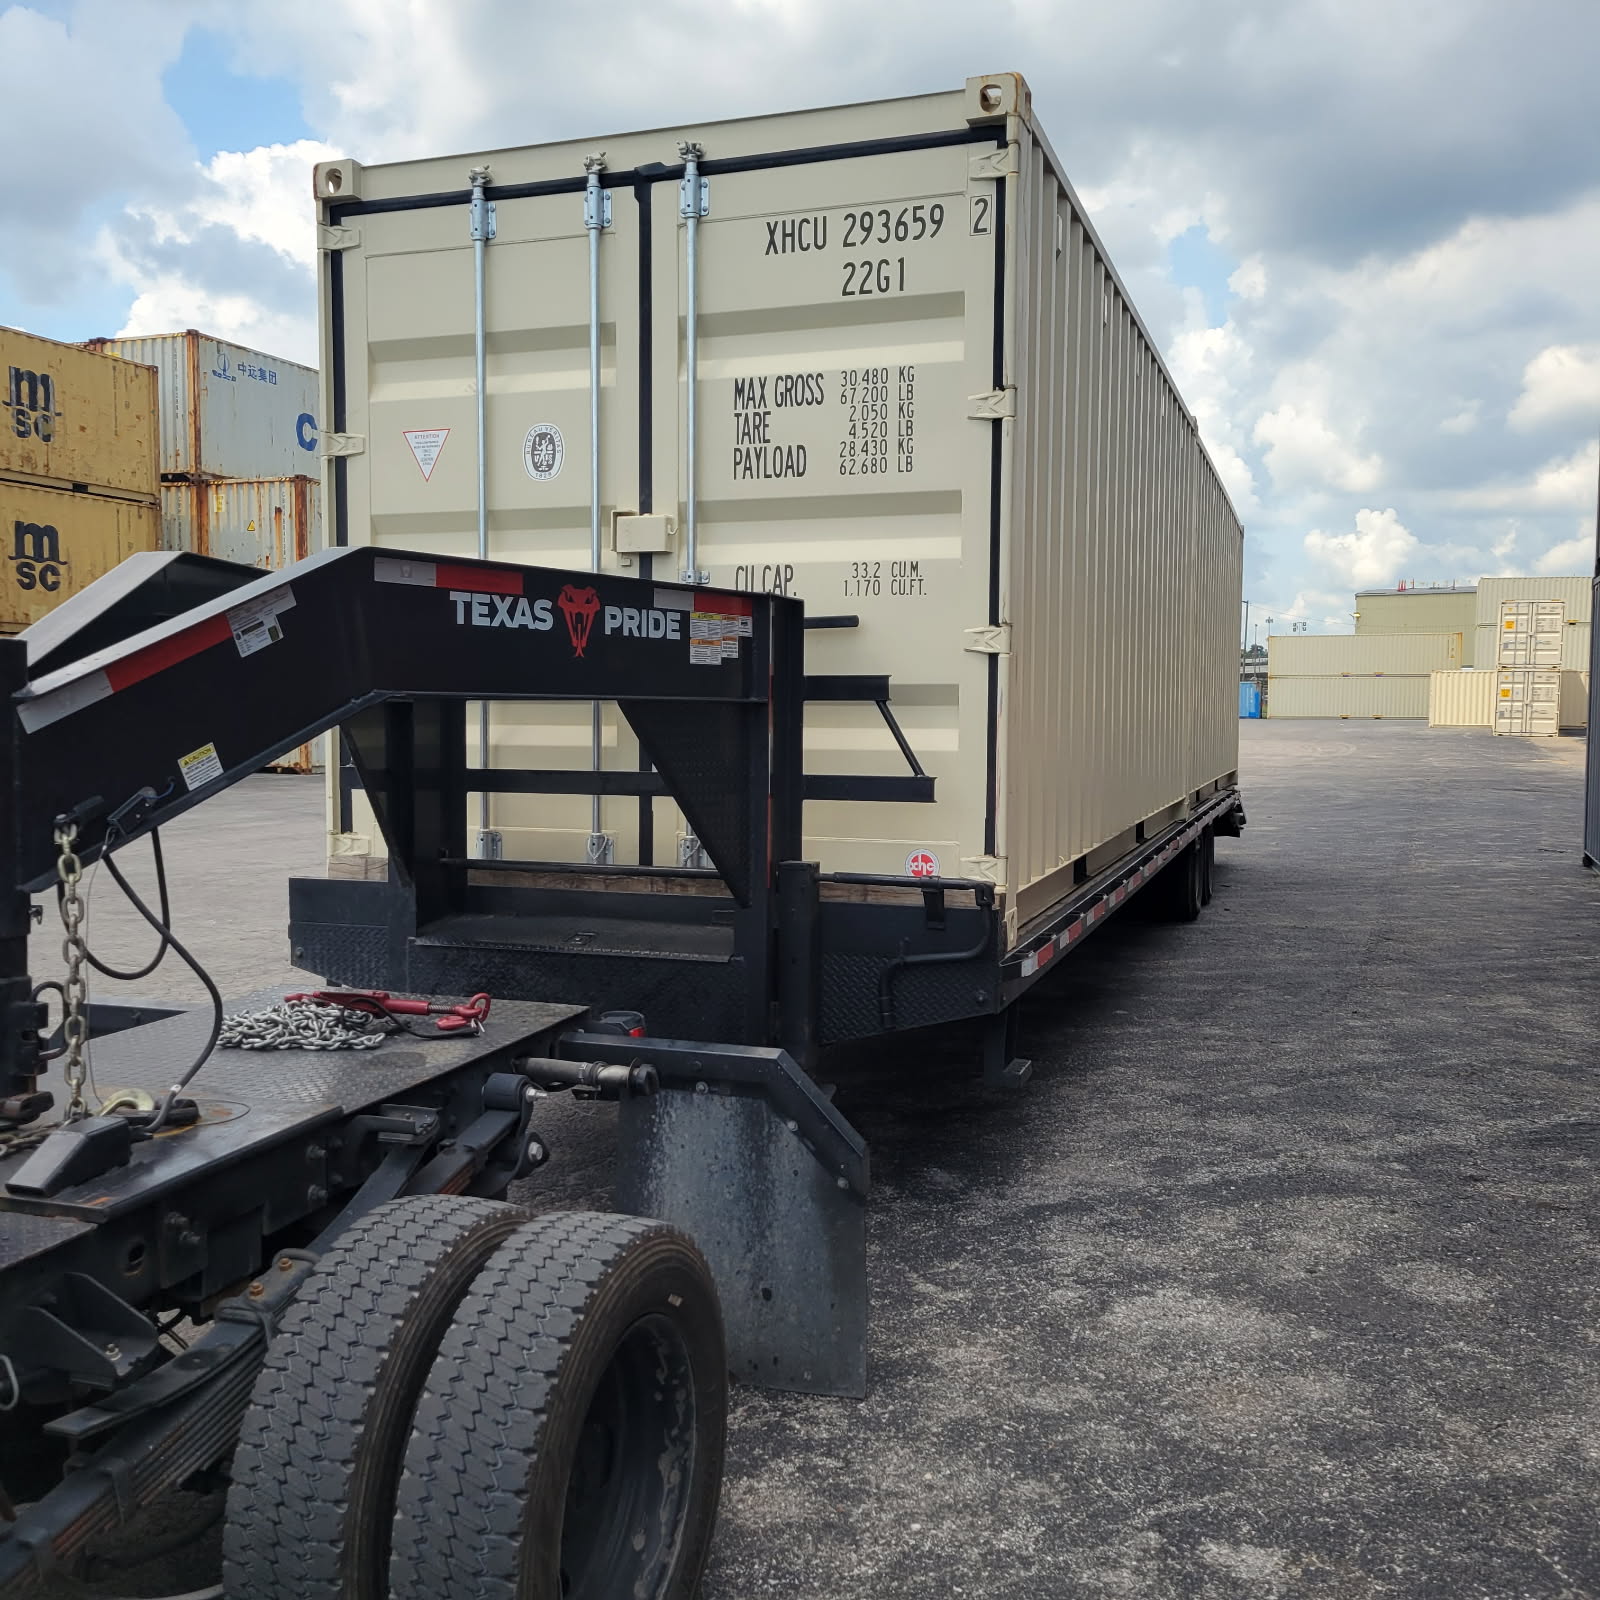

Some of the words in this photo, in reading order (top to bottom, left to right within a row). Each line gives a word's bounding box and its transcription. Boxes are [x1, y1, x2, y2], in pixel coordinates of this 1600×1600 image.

[765, 215, 827, 255] XHCU
[842, 204, 945, 248] 293659
[973, 197, 989, 233] 2
[841, 257, 905, 296] 22G1
[238, 361, 277, 385] 中远集团
[898, 366, 915, 383] KG
[734, 376, 768, 410] MAX
[774, 373, 825, 407] GROSS
[898, 384, 914, 401] LB
[898, 402, 914, 419] KG
[734, 411, 772, 445] TARE
[898, 420, 914, 437] LB
[898, 438, 914, 455] KG
[733, 444, 807, 480] PAYLOAD
[898, 455, 913, 472] LB
[851, 562, 881, 578] 33.2
[449, 590, 554, 632] TEXAS
[604, 606, 681, 641] PRIDE
